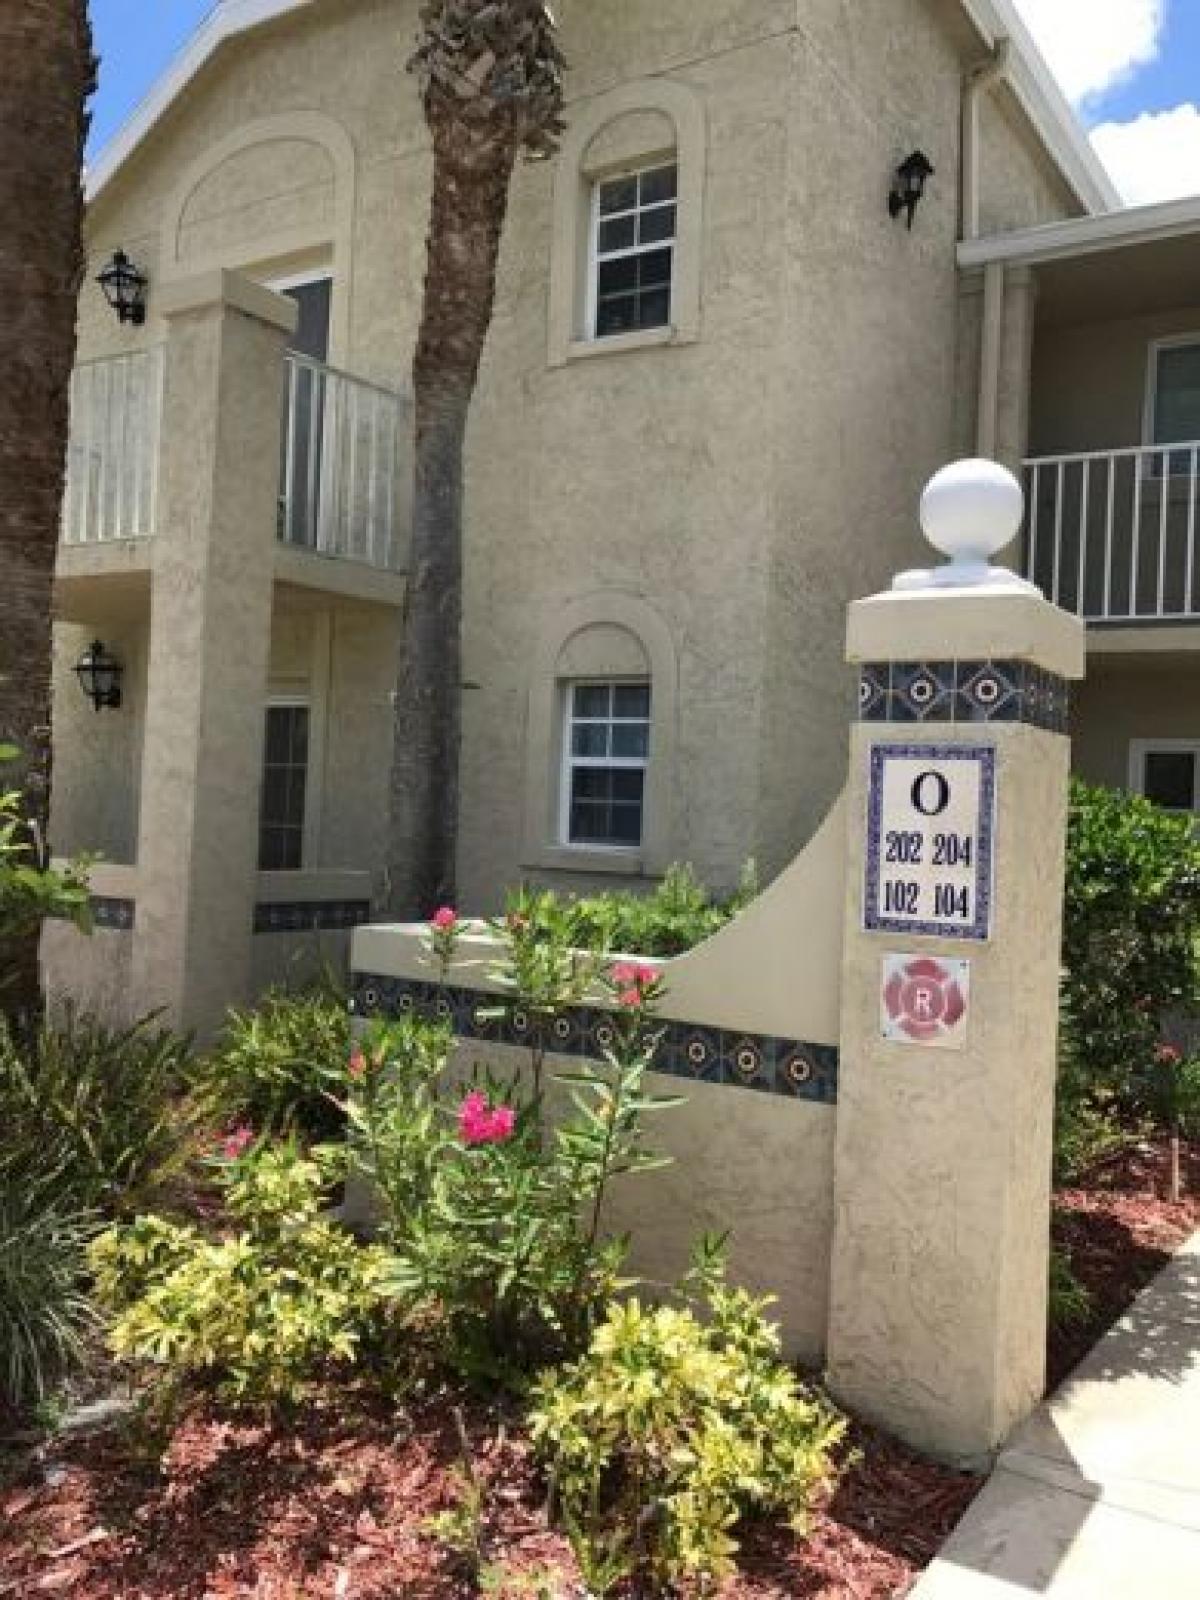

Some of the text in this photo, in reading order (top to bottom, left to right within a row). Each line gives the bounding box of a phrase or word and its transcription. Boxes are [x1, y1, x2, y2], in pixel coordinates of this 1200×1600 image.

[911, 771, 950, 816] O
[885, 831, 973, 868] 202 204
[885, 880, 970, 917] 102 104
[915, 989, 930, 1014] R
